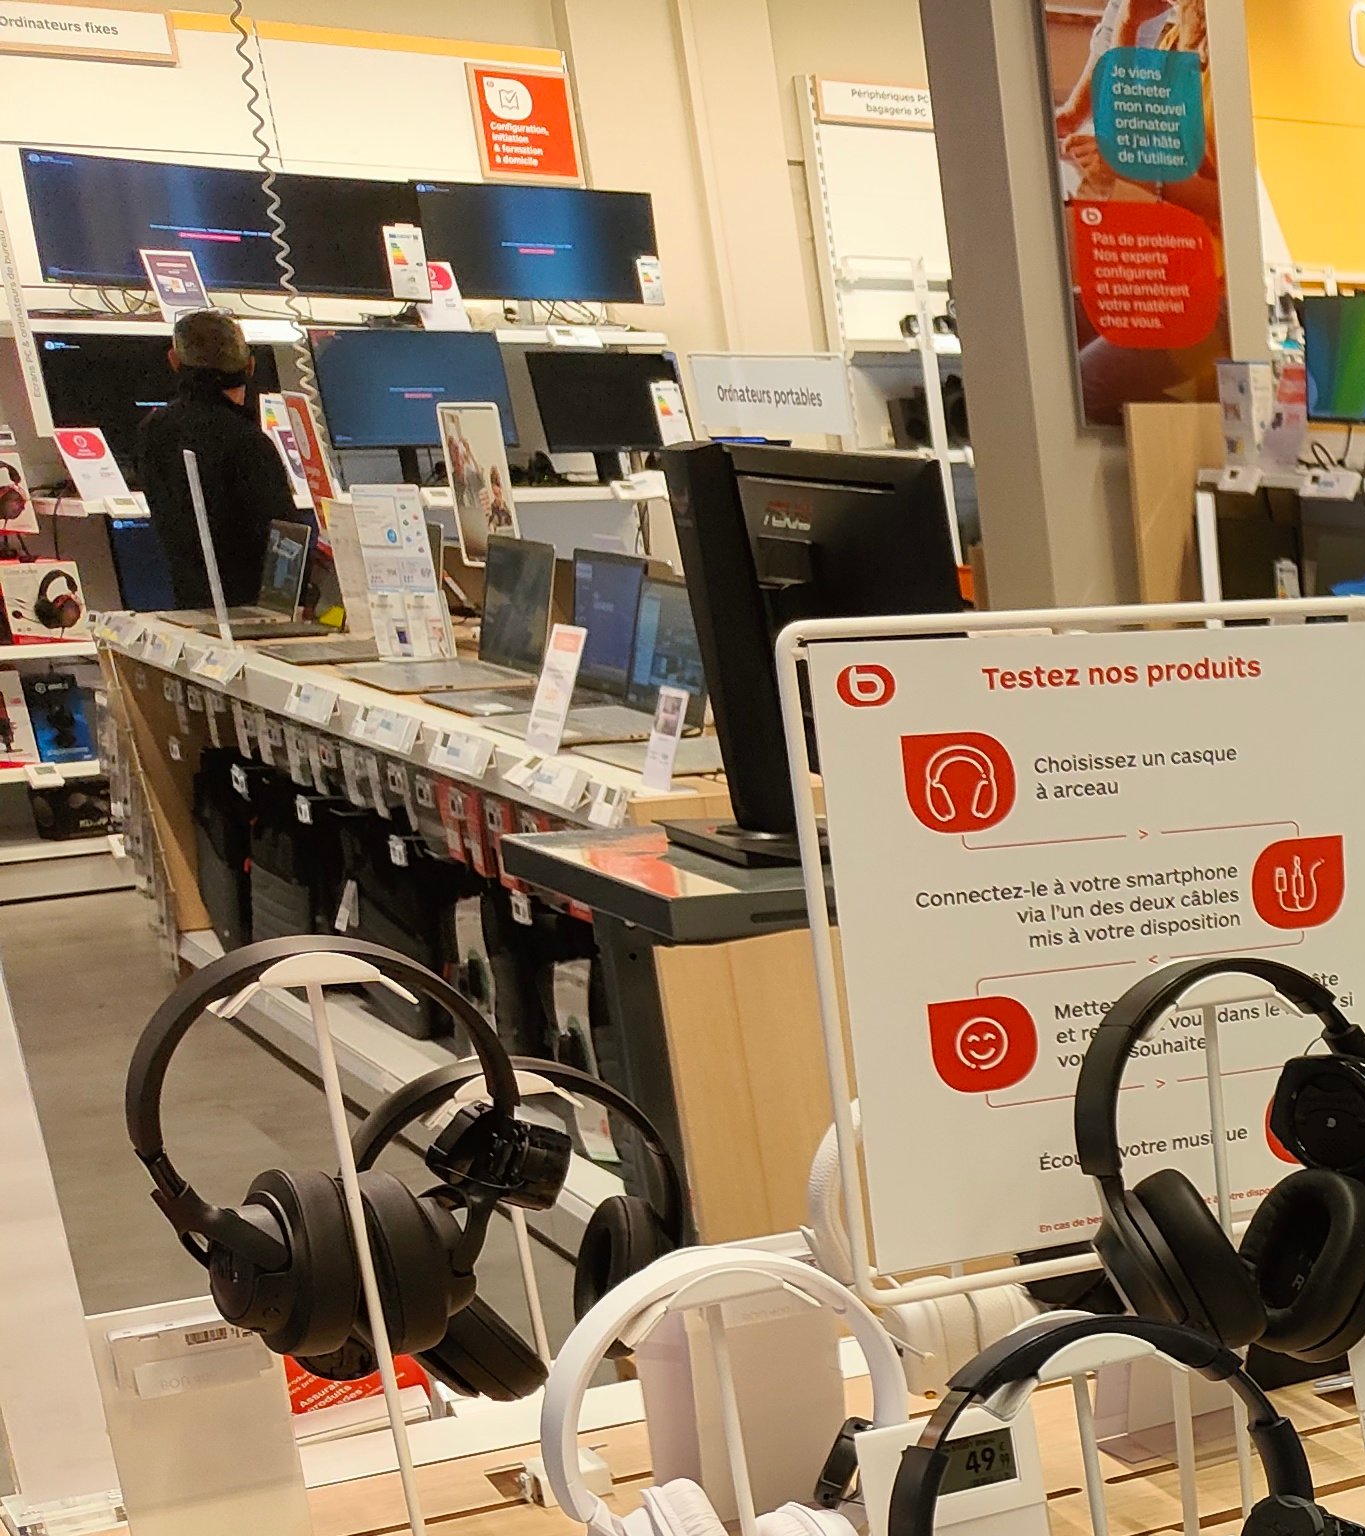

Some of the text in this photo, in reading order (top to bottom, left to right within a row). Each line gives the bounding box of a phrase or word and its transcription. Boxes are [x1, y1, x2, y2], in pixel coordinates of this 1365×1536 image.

[86, 22, 118, 35] fixes
[1112, 66, 1161, 80] Je viens
[851, 89, 928, 103] Périphériques PC
[1112, 82, 1171, 97] d'acheter
[866, 104, 926, 116] bagagerie PC
[1114, 101, 1186, 116] mon nouvel
[1116, 117, 1180, 131] ordinateur
[1117, 134, 1180, 148] et j'ai hâte
[1118, 149, 1188, 166] de l'utiliser.
[1092, 232, 1115, 245] Pas
[1118, 233, 1134, 246] de
[1137, 234, 1196, 249] problème
[1093, 248, 1168, 264] Nos experts
[1095, 266, 1166, 281] configurent
[1097, 282, 1110, 294] et
[1098, 299, 1184, 313] votre matériel
[1100, 315, 1129, 328] chez
[774, 388, 822, 408] portables
[982, 656, 1261, 691] Testez nos produits
[1034, 747, 1238, 774] Choisissez un casque
[1036, 781, 1119, 800] à arceau
[916, 865, 1238, 909] Connectez-le à votre smartphone
[1017, 888, 1239, 925] via l'un des deux câbles
[1029, 912, 1241, 948] mis à votre disposition
[1040, 1218, 1084, 1233] En cas de
